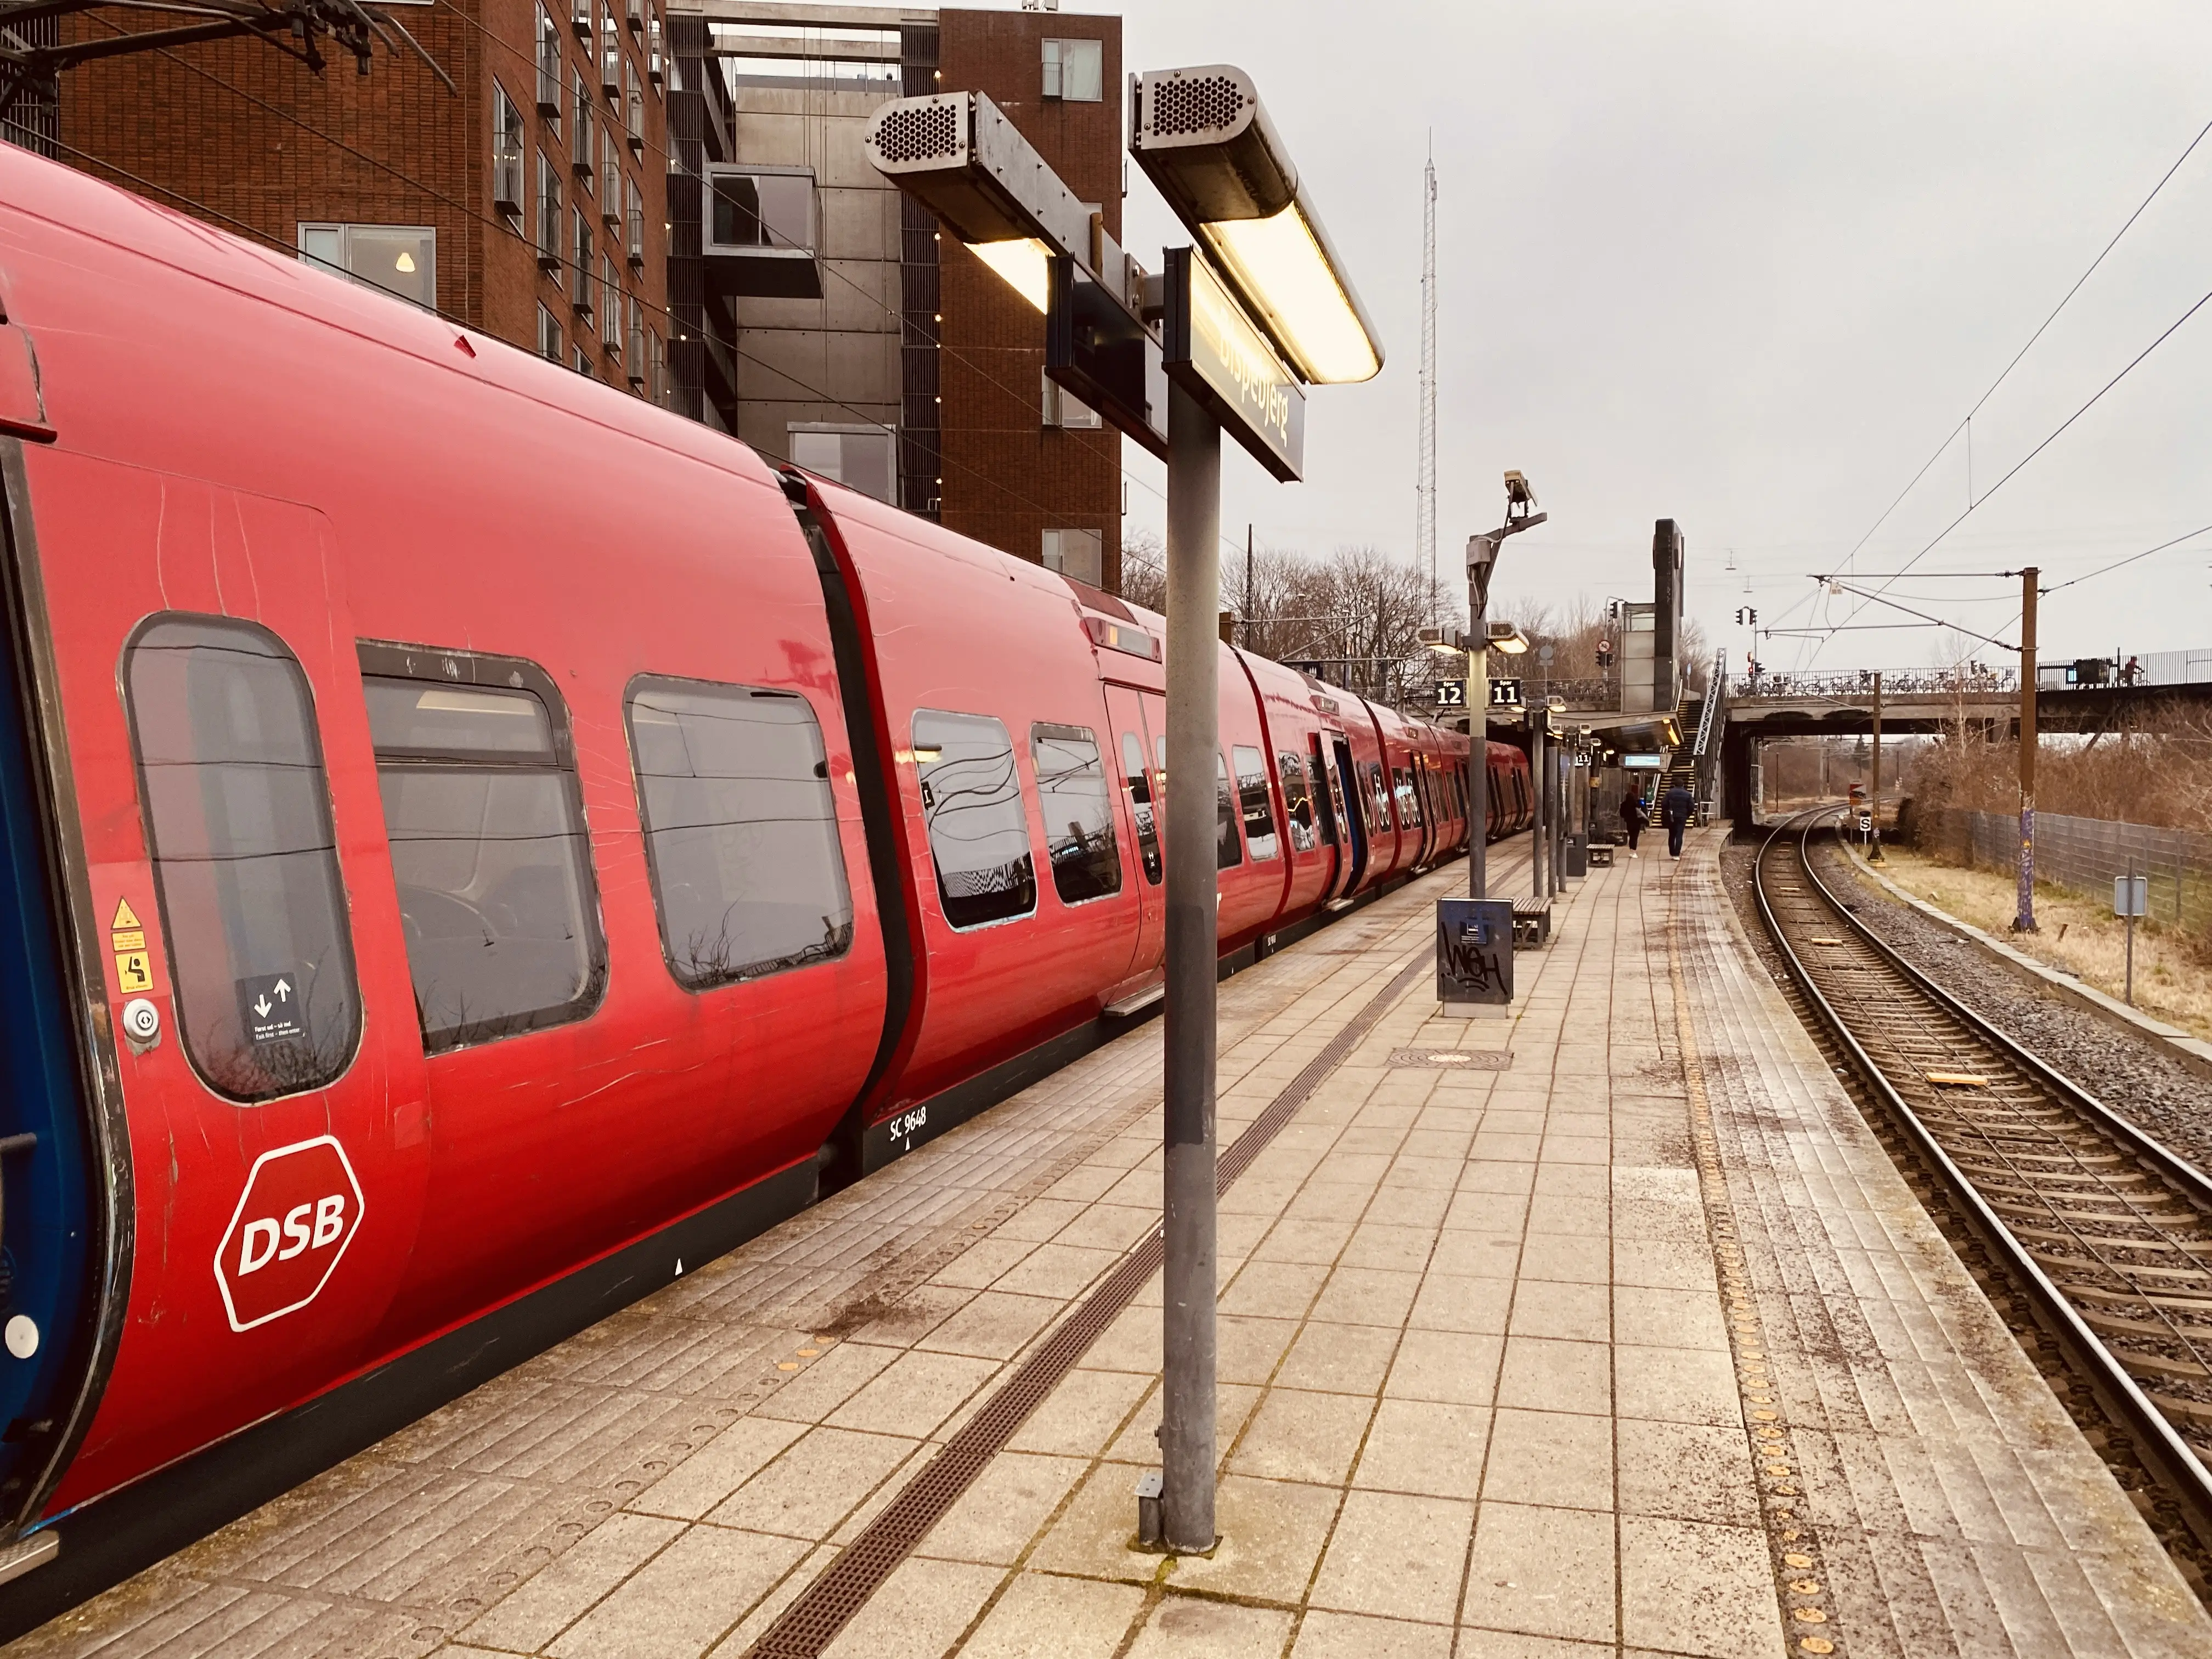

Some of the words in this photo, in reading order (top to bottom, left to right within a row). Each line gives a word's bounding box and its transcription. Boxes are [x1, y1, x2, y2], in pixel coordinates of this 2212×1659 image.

[1437, 687, 1461, 704] 12
[1494, 687, 1517, 703] 11
[1861, 819, 1870, 829] S
[890, 1117, 902, 1142] SC
[905, 1106, 927, 1135] 9648
[238, 1194, 345, 1277] DSB
